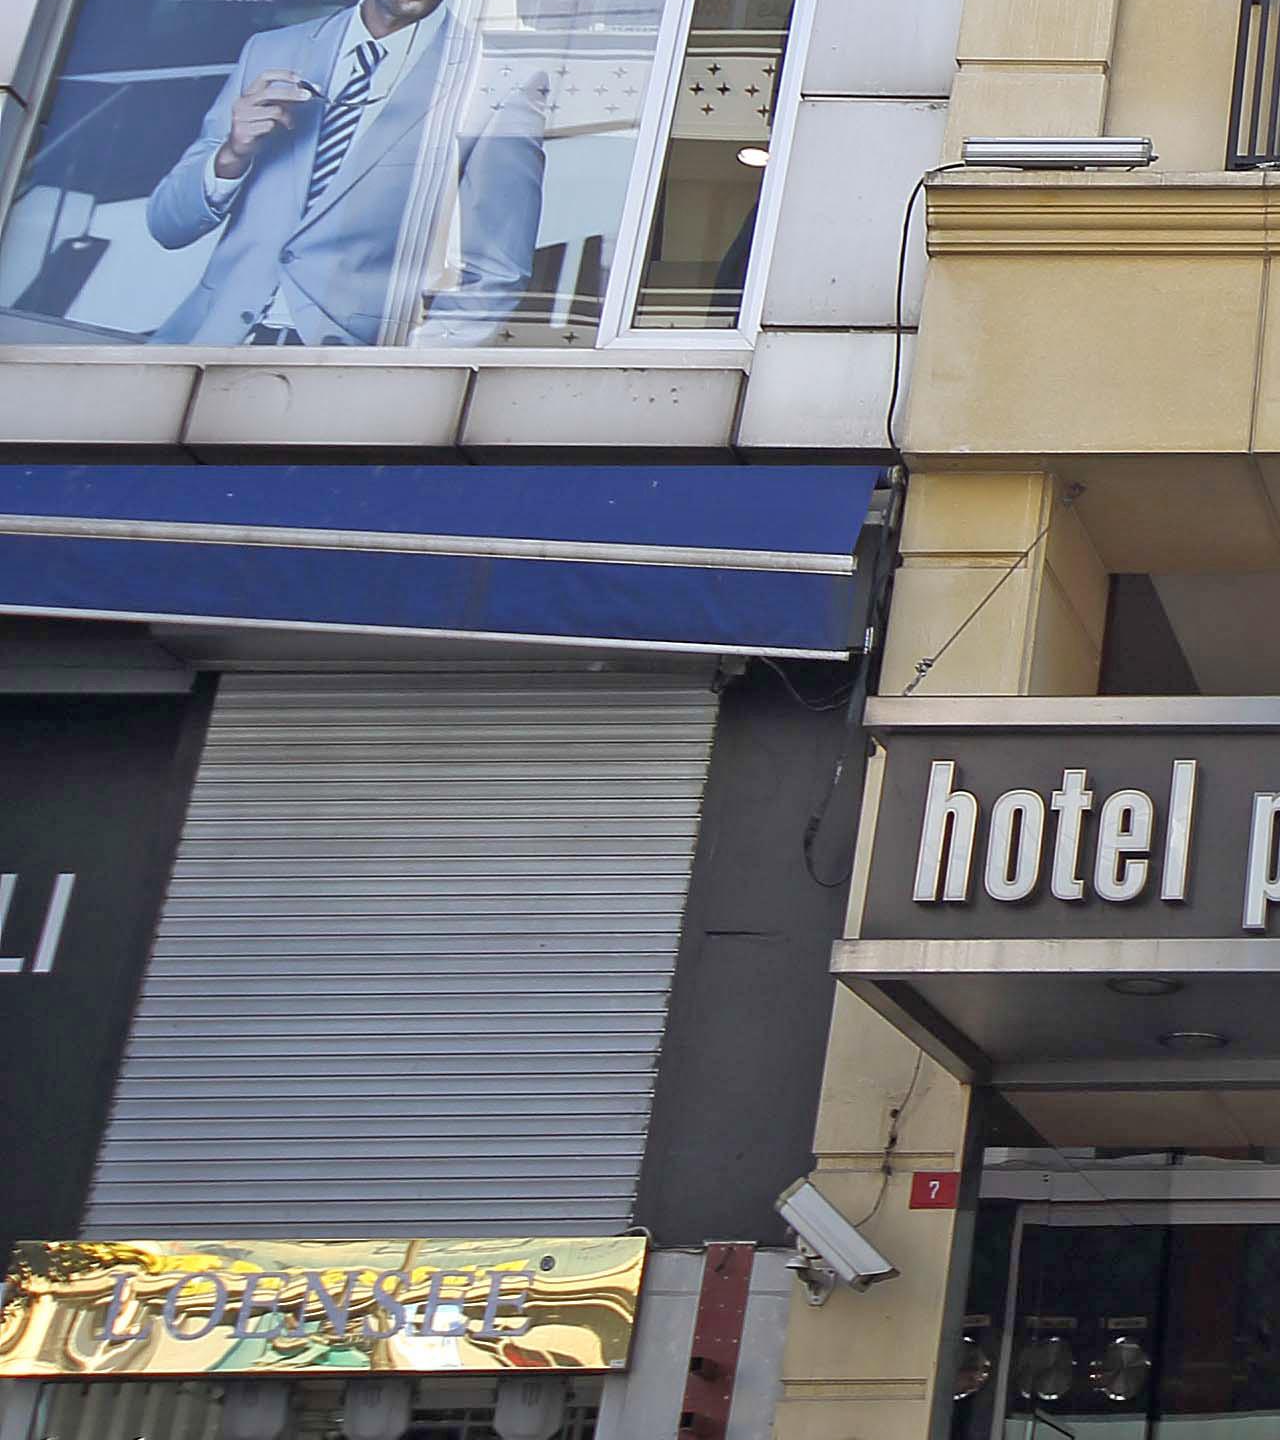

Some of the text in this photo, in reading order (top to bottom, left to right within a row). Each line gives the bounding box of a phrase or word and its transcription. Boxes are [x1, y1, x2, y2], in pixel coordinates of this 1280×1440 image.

[912, 758, 1198, 904] hotel
[929, 1180, 941, 1200] 7
[97, 1267, 538, 1343] LOENSEE
